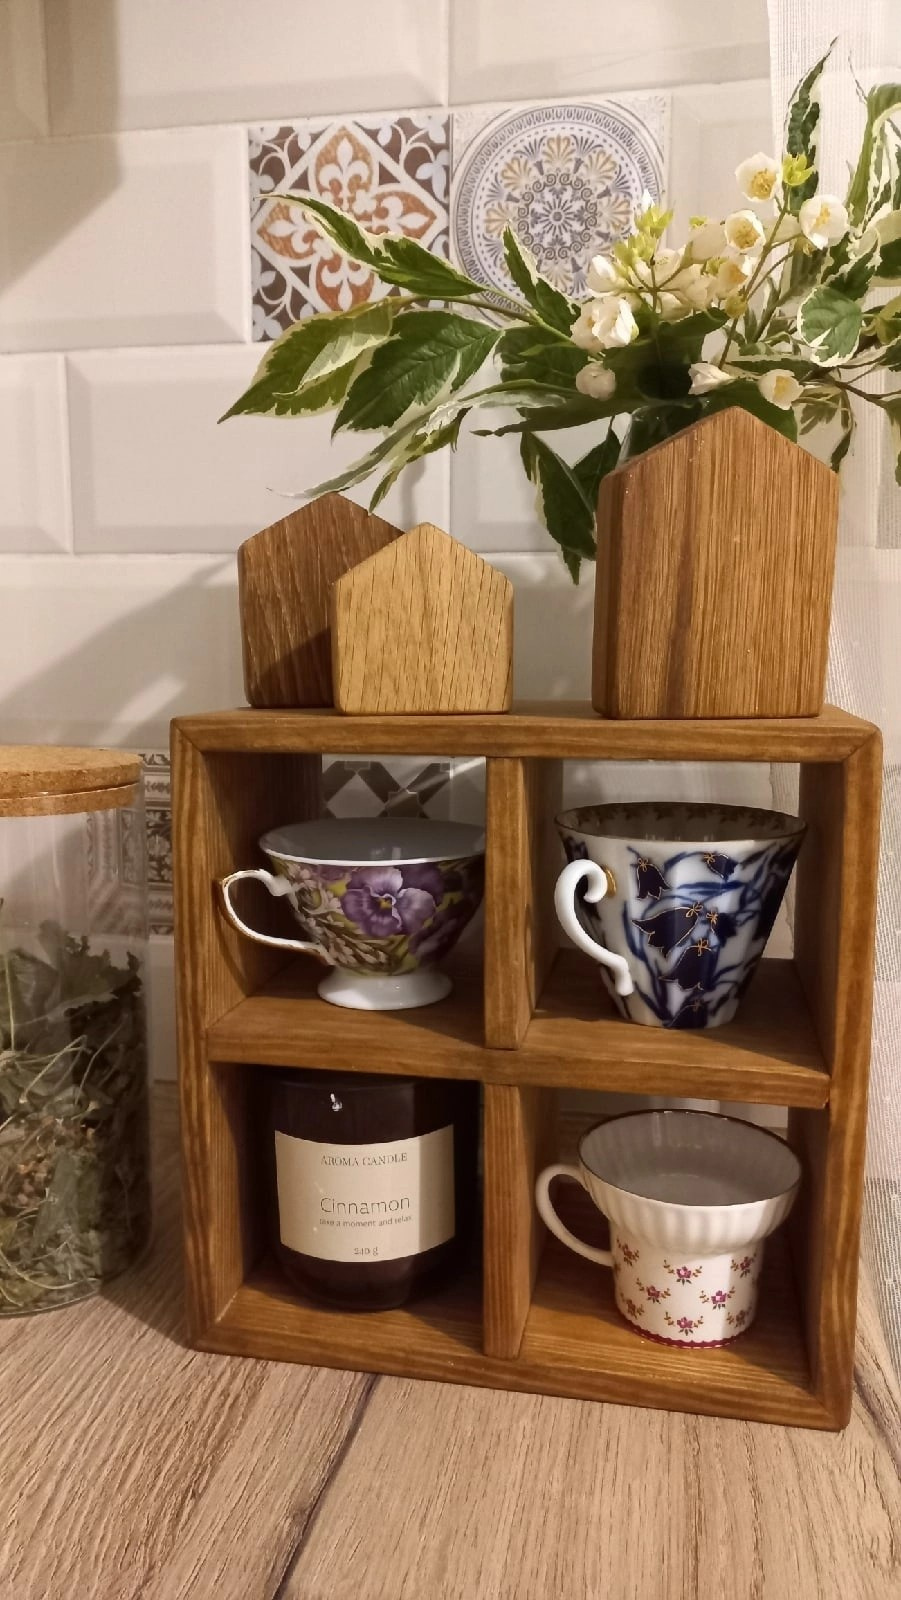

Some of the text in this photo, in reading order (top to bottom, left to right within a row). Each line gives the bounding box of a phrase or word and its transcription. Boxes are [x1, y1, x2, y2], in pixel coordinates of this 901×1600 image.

[320, 1152, 408, 1167] AROMA CANDLE
[320, 1197, 410, 1215] Cinnamon
[378, 1218, 393, 1226] and
